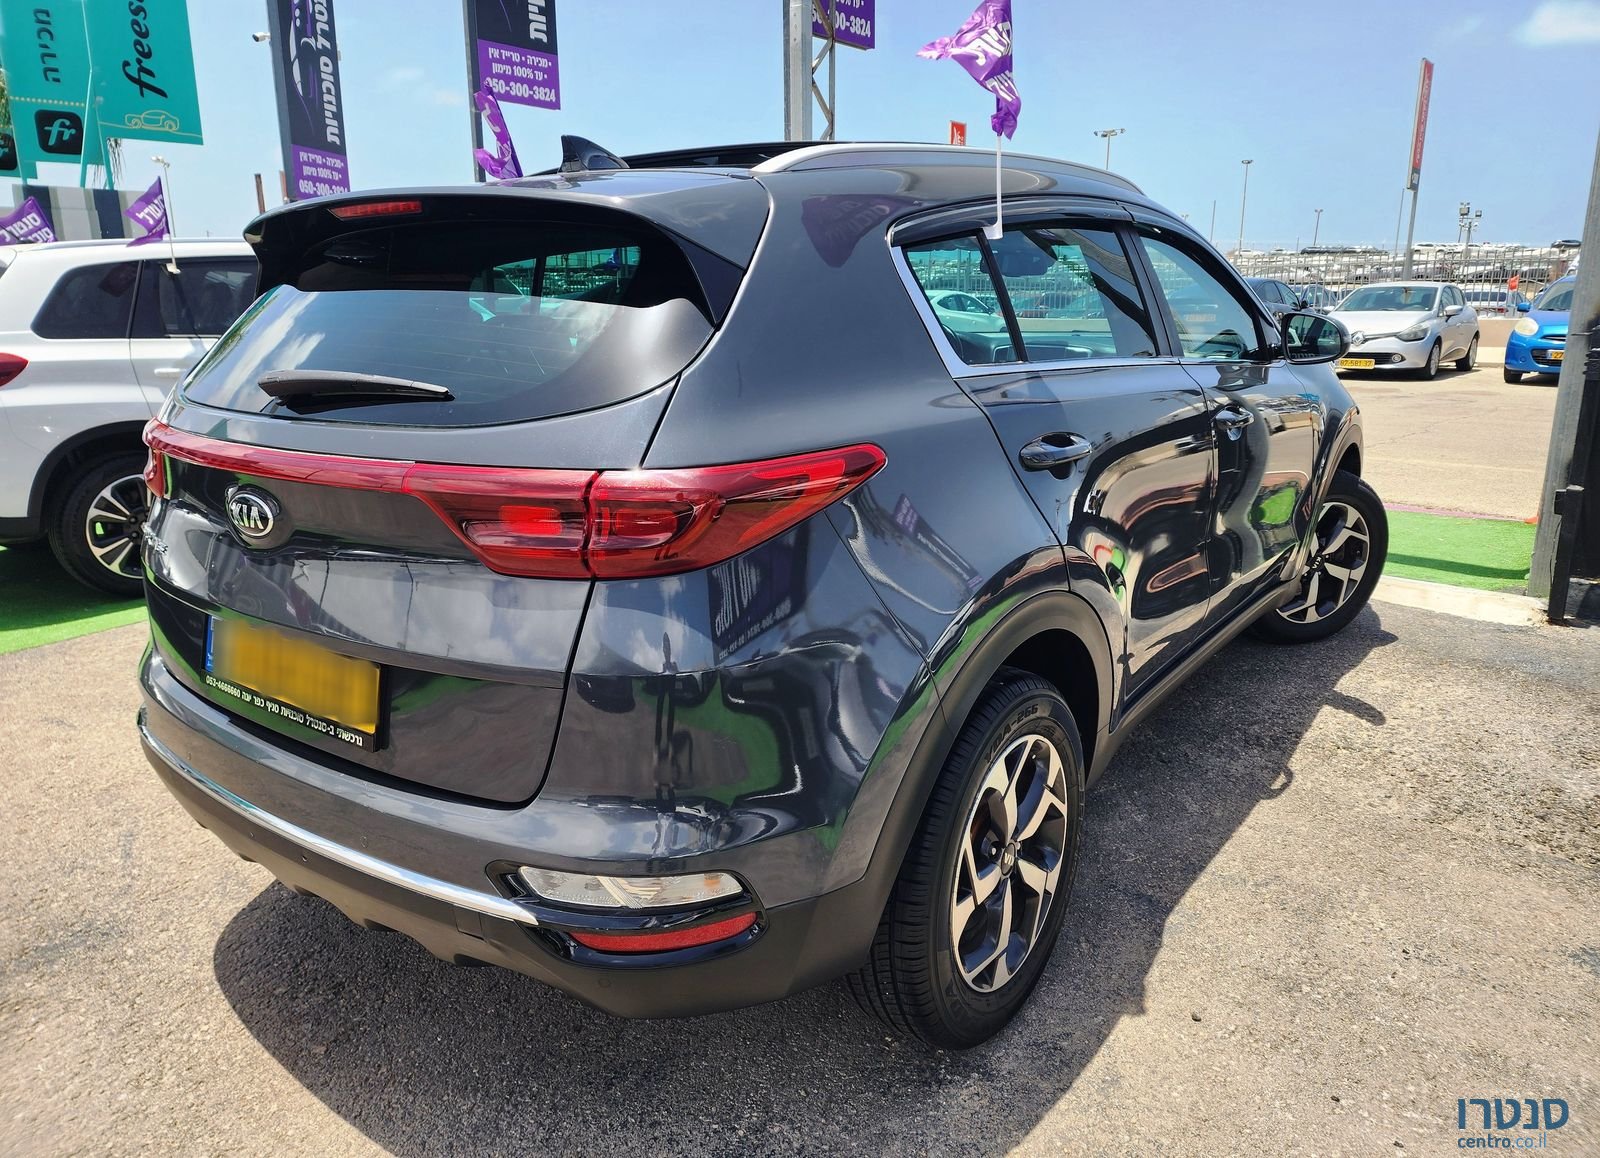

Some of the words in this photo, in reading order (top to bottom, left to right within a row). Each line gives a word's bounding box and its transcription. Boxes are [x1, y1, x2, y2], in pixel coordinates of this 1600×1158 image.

[33, 8, 61, 83] מכירה
[121, 0, 168, 99] frees
[488, 47, 500, 59] אין
[500, 49, 520, 63] טרייד
[492, 62, 512, 75] מימון
[526, 55, 548, 68] מכירה
[513, 65, 534, 79] 100%
[534, 70, 543, 81] עד
[319, 55, 341, 146] סוכנויות
[44, 119, 76, 146] fr
[231, 502, 265, 530] KIA
